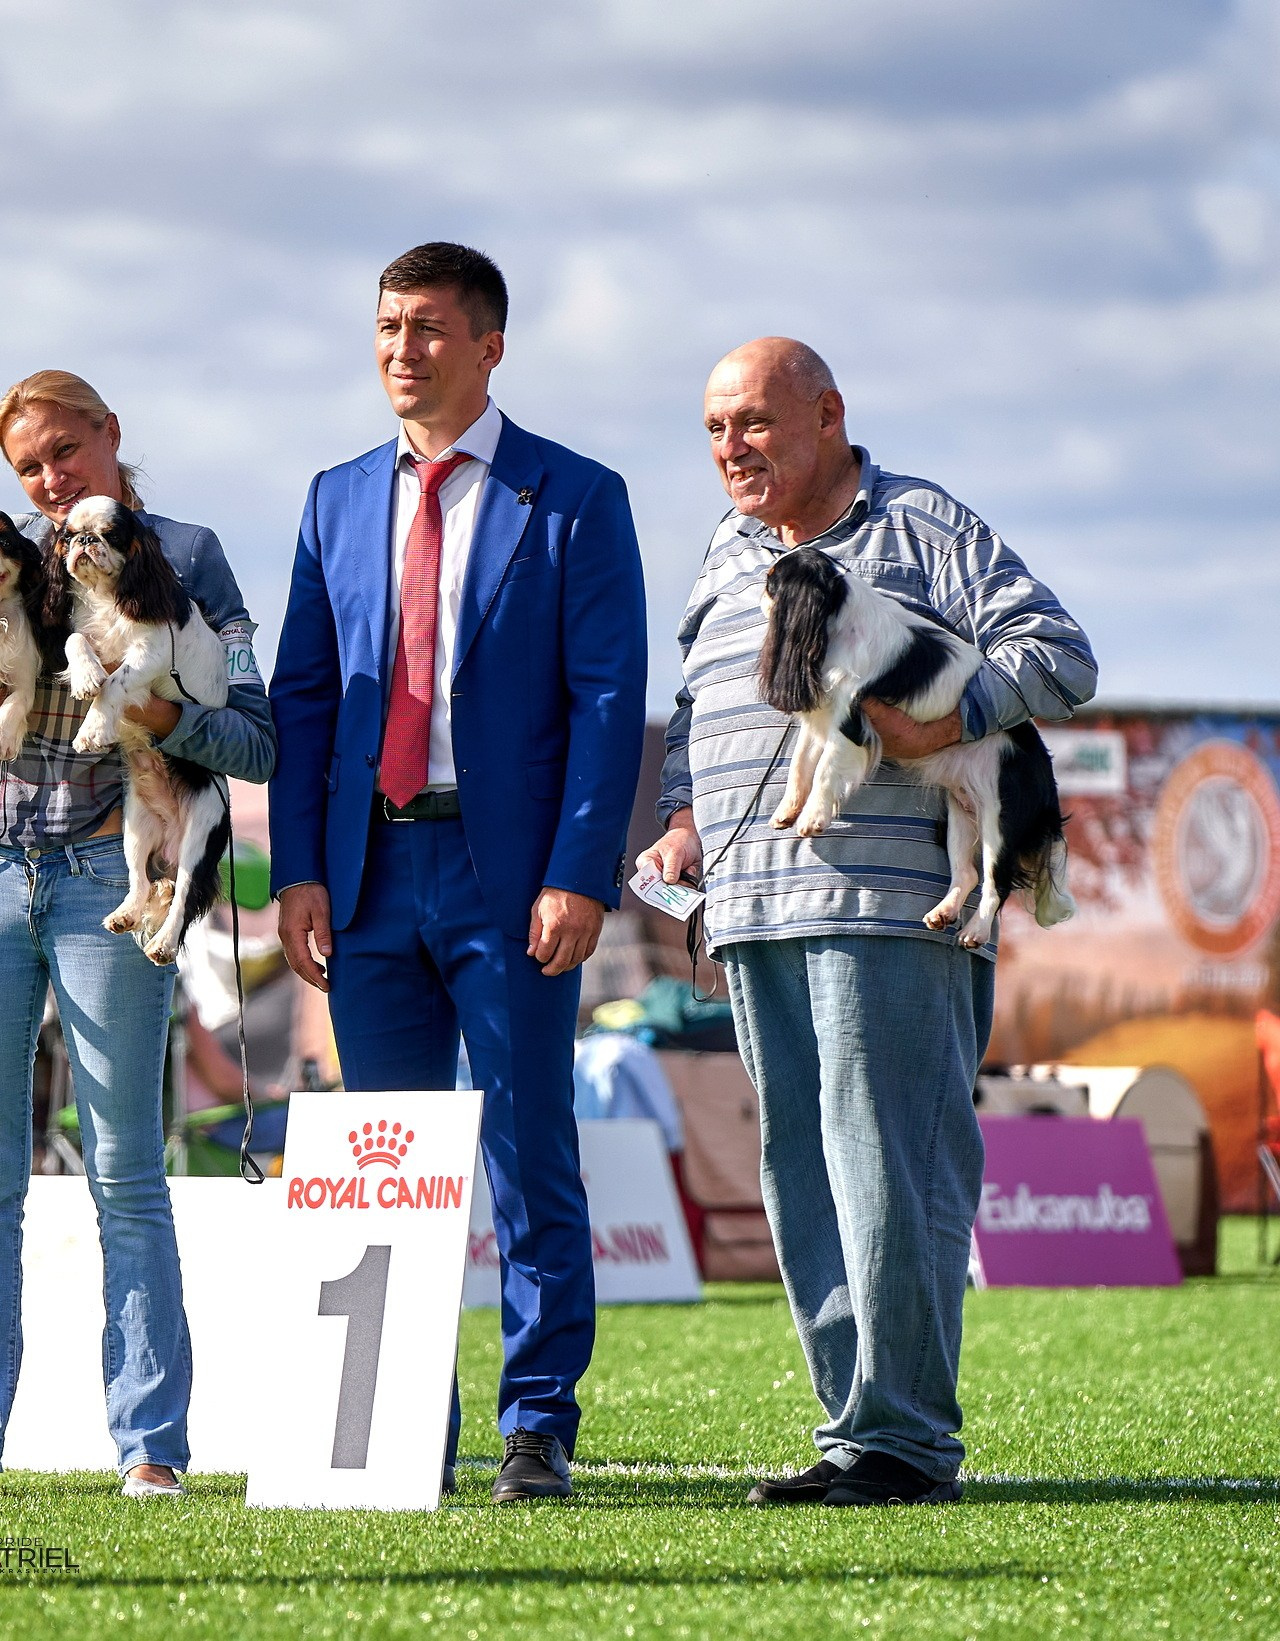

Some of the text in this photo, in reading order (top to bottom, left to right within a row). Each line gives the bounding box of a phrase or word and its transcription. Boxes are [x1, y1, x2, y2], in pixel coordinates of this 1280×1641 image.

[288, 1176, 463, 1210] ROYAL CANIN
[980, 1182, 1152, 1234] Eukanuba
[318, 1245, 392, 1469] 1
